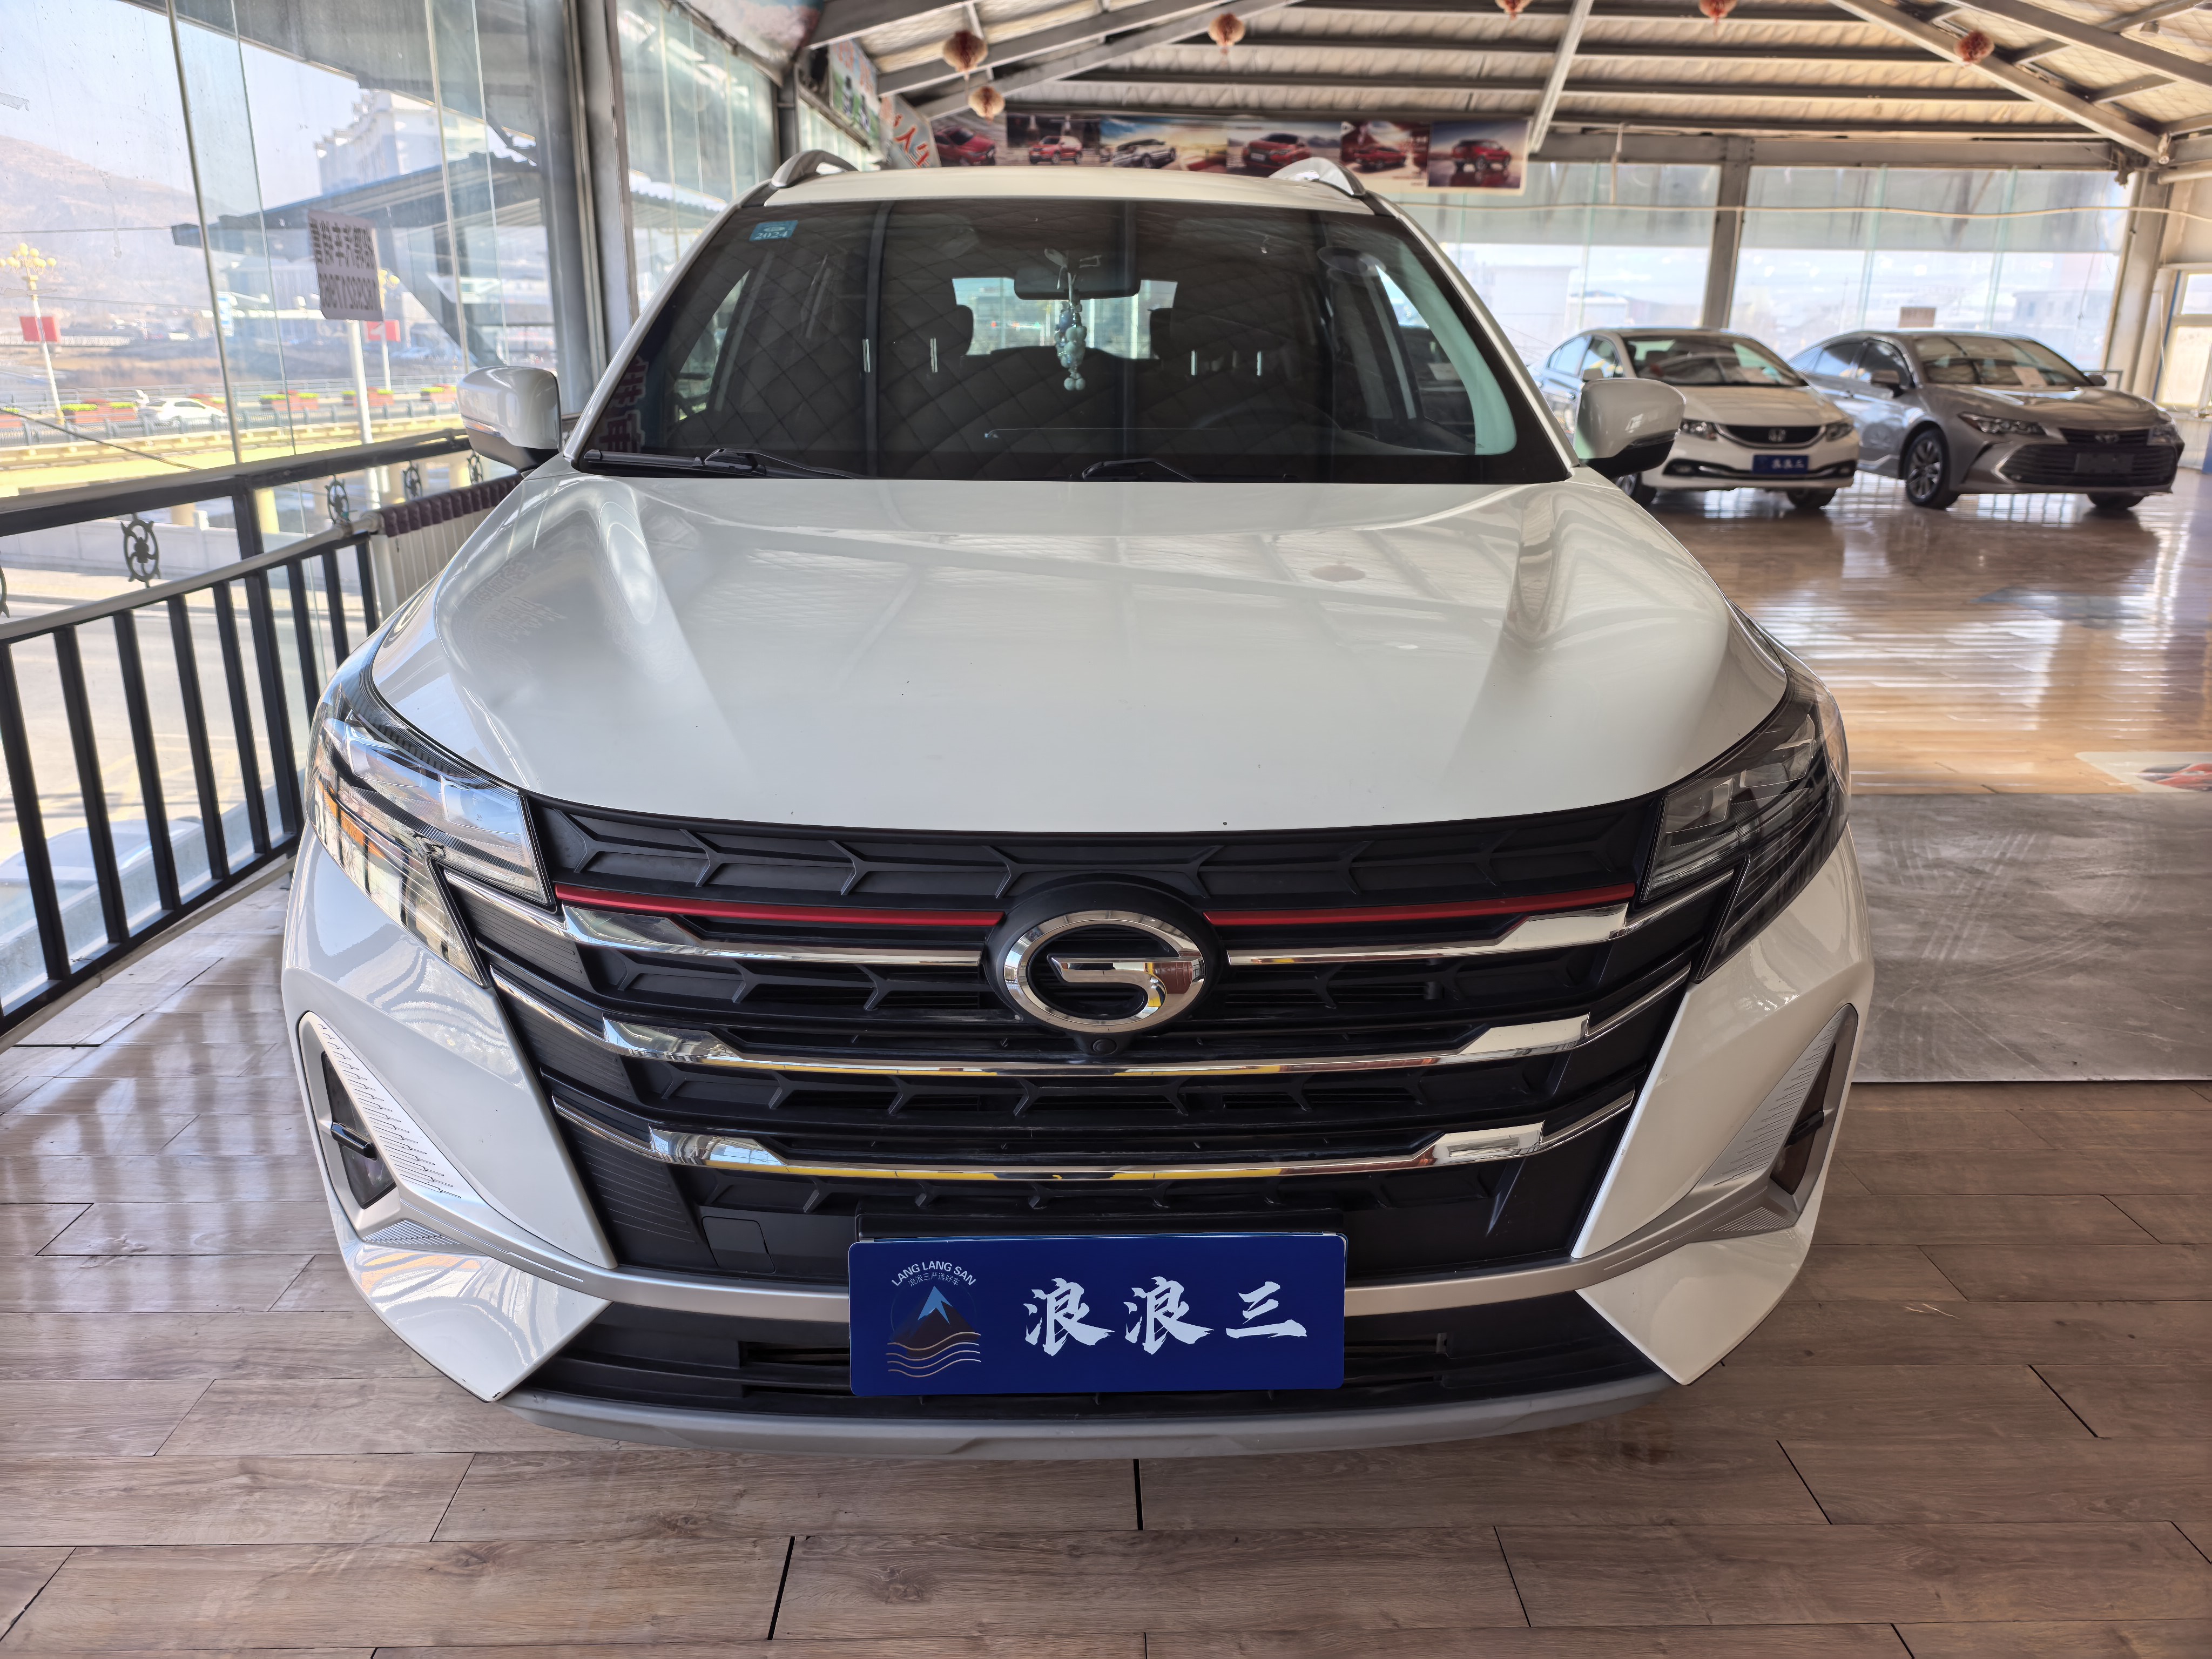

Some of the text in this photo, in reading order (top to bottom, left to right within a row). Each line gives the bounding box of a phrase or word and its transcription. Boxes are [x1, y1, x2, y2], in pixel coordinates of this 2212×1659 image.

[755, 231, 788, 239] 2024
[891, 1260, 976, 1286] LANG LANG SAN
[1023, 1276, 1307, 1356] 浪浪三
